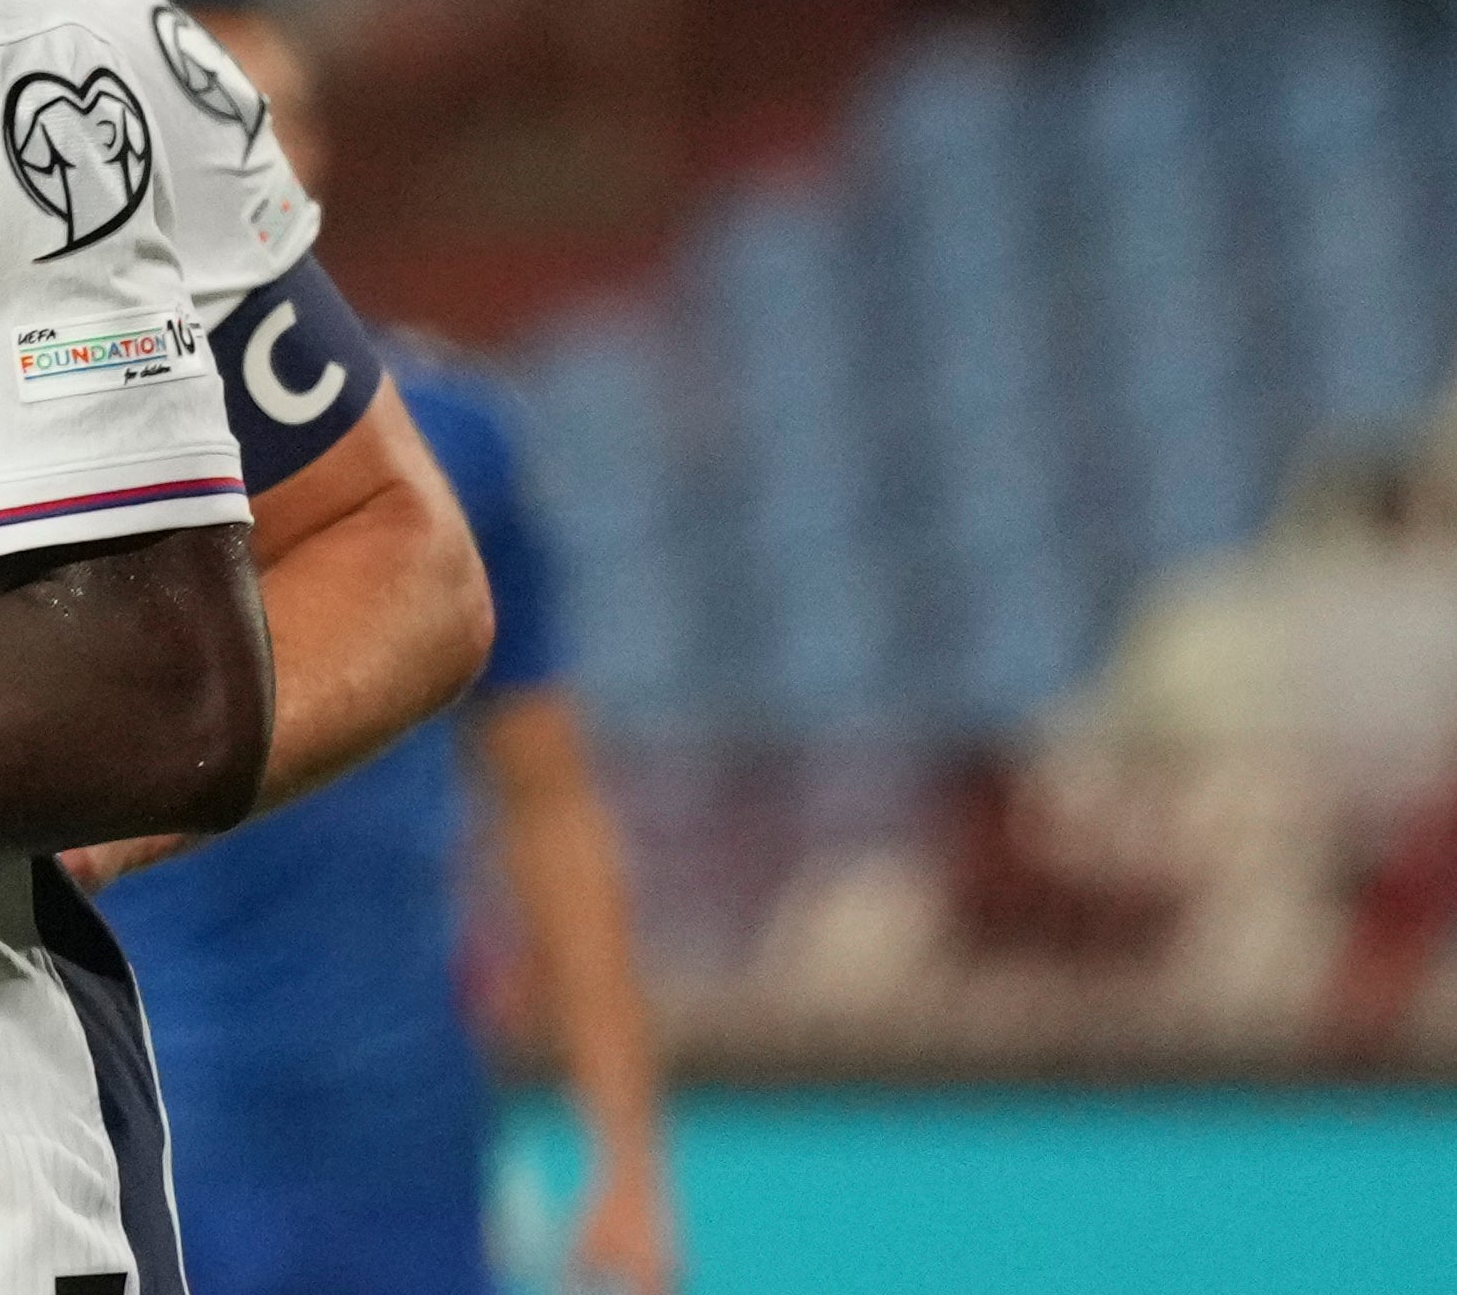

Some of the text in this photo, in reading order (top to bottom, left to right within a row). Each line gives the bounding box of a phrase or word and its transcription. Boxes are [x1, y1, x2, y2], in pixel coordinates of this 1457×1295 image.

[18, 328, 57, 346] UEFA
[20, 334, 167, 374] FOUNDATION
[243, 300, 346, 425] C
